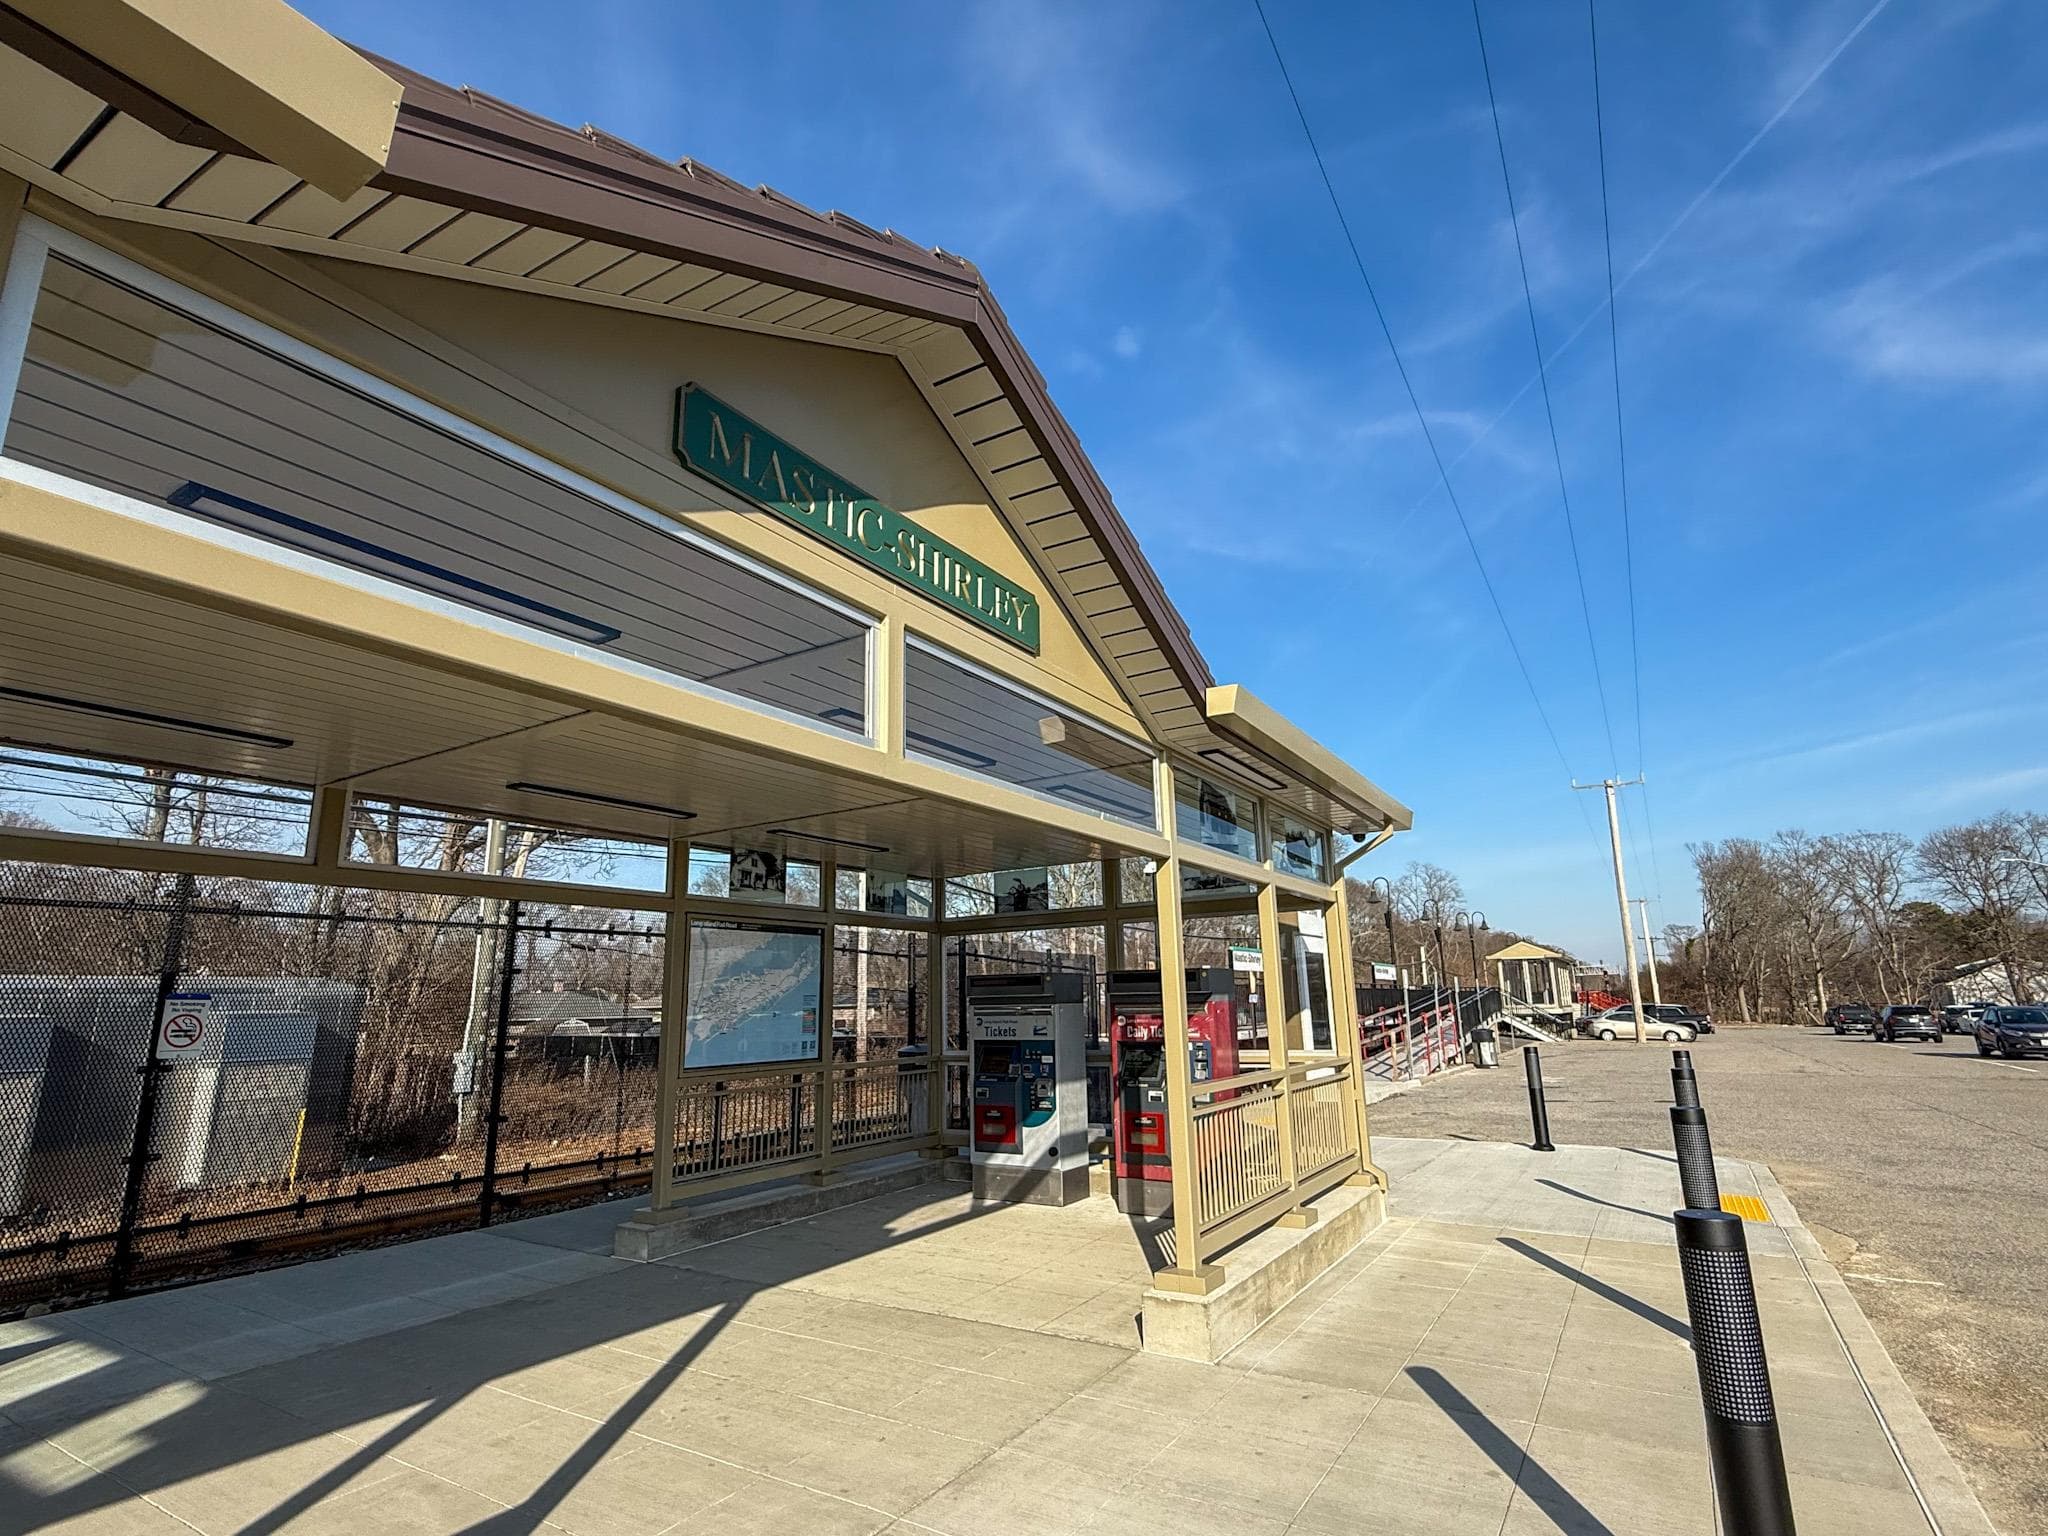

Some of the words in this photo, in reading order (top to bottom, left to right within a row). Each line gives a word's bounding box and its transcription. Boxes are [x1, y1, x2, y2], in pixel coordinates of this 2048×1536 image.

[710, 411, 1031, 633] MASTIC-SHIRLEY
[984, 1026, 1017, 1037] Tickets
[1127, 1026, 1148, 1040] Daily
